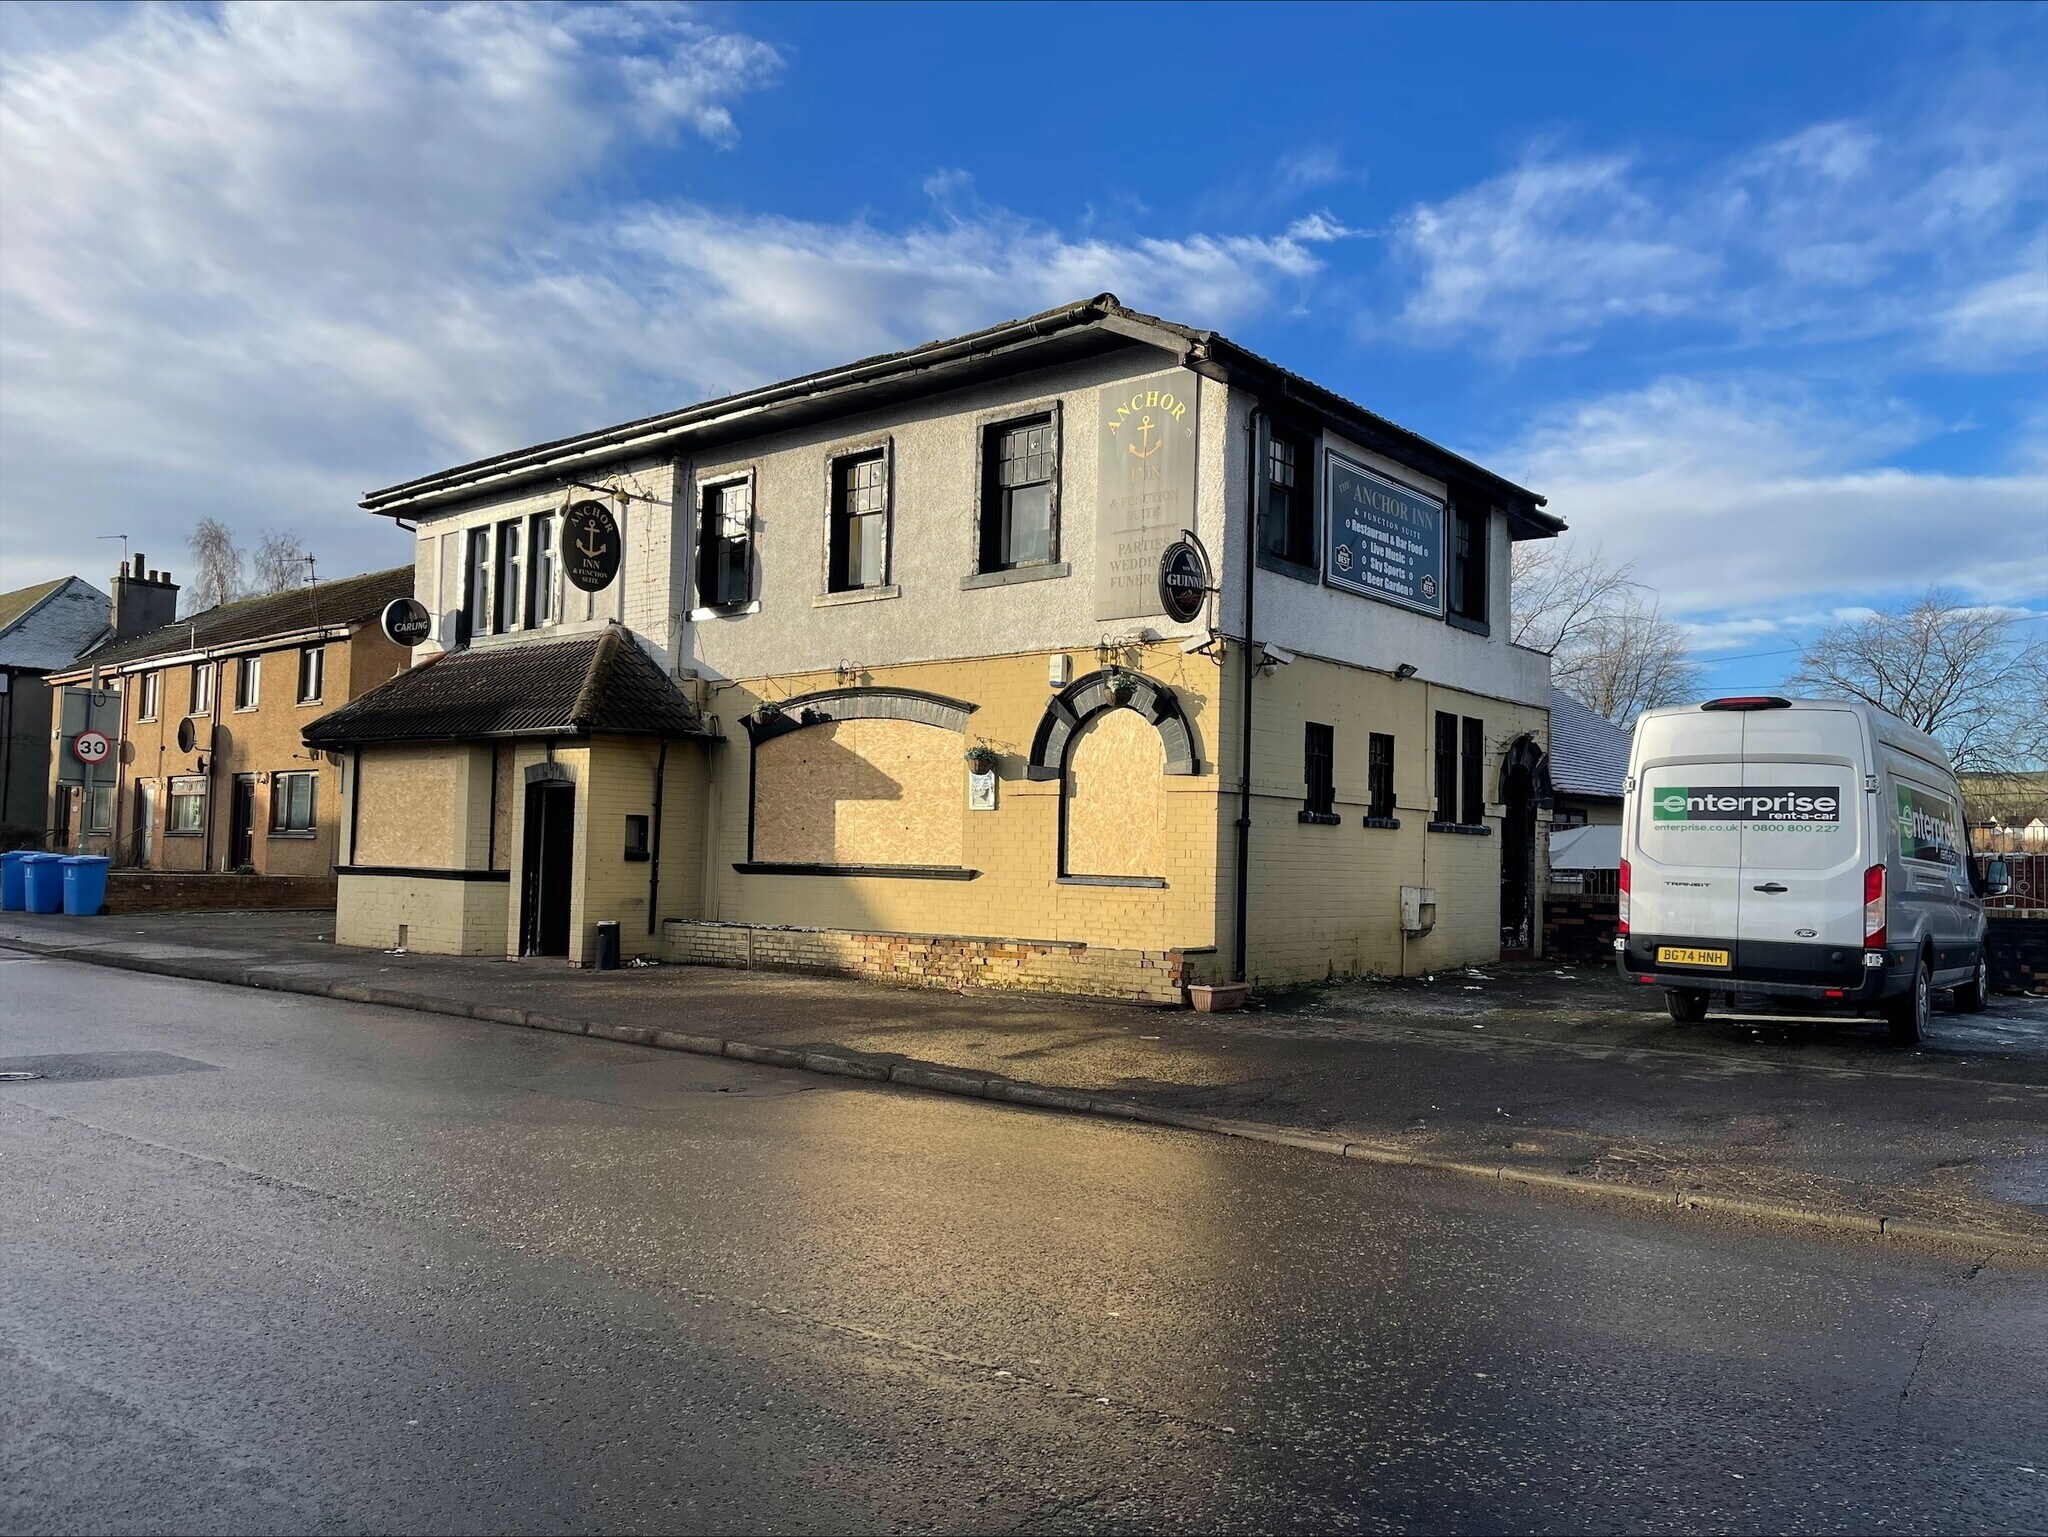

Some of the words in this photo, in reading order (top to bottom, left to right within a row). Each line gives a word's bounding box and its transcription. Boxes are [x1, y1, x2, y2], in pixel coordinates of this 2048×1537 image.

[1108, 390, 1186, 435] ANCHOR
[1353, 484, 1408, 521] ANCHOR
[1412, 507, 1433, 530] INN
[571, 506, 614, 534] ANCHOR
[1354, 507, 1360, 516] &
[1363, 511, 1399, 531] FUNCTION
[1401, 526, 1421, 539] SUITE
[1118, 537, 1170, 554] PARTIES
[1351, 518, 1389, 544] Restaurant
[1390, 535, 1395, 546] &
[1396, 536, 1408, 550] Bar
[1407, 540, 1423, 556] Food
[1370, 541, 1384, 557] Live
[1385, 546, 1406, 564] Music
[583, 558, 600, 569] INN
[1110, 556, 1161, 573] WEDDIN
[1370, 557, 1383, 573] Sky
[1384, 561, 1406, 580] Sports
[579, 568, 608, 578] FUNCTION
[582, 576, 599, 584] SUITE
[1110, 573, 1159, 588] FUNERA
[1167, 574, 1203, 589] GUINN
[1367, 571, 1384, 587] Beer
[1384, 577, 1409, 596] Garden
[394, 621, 428, 632] CARLING
[80, 741, 106, 755] 30
[1662, 792, 1837, 817] enterprise
[1768, 811, 1836, 820] rent-a-car
[1654, 823, 1739, 833] enterprise.co.uk
[1752, 824, 1784, 833] 0800
[1787, 824, 1812, 833] 800
[1815, 825, 1840, 833] 227
[1664, 949, 1695, 962] BG74
[1698, 951, 1723, 964] HNH
